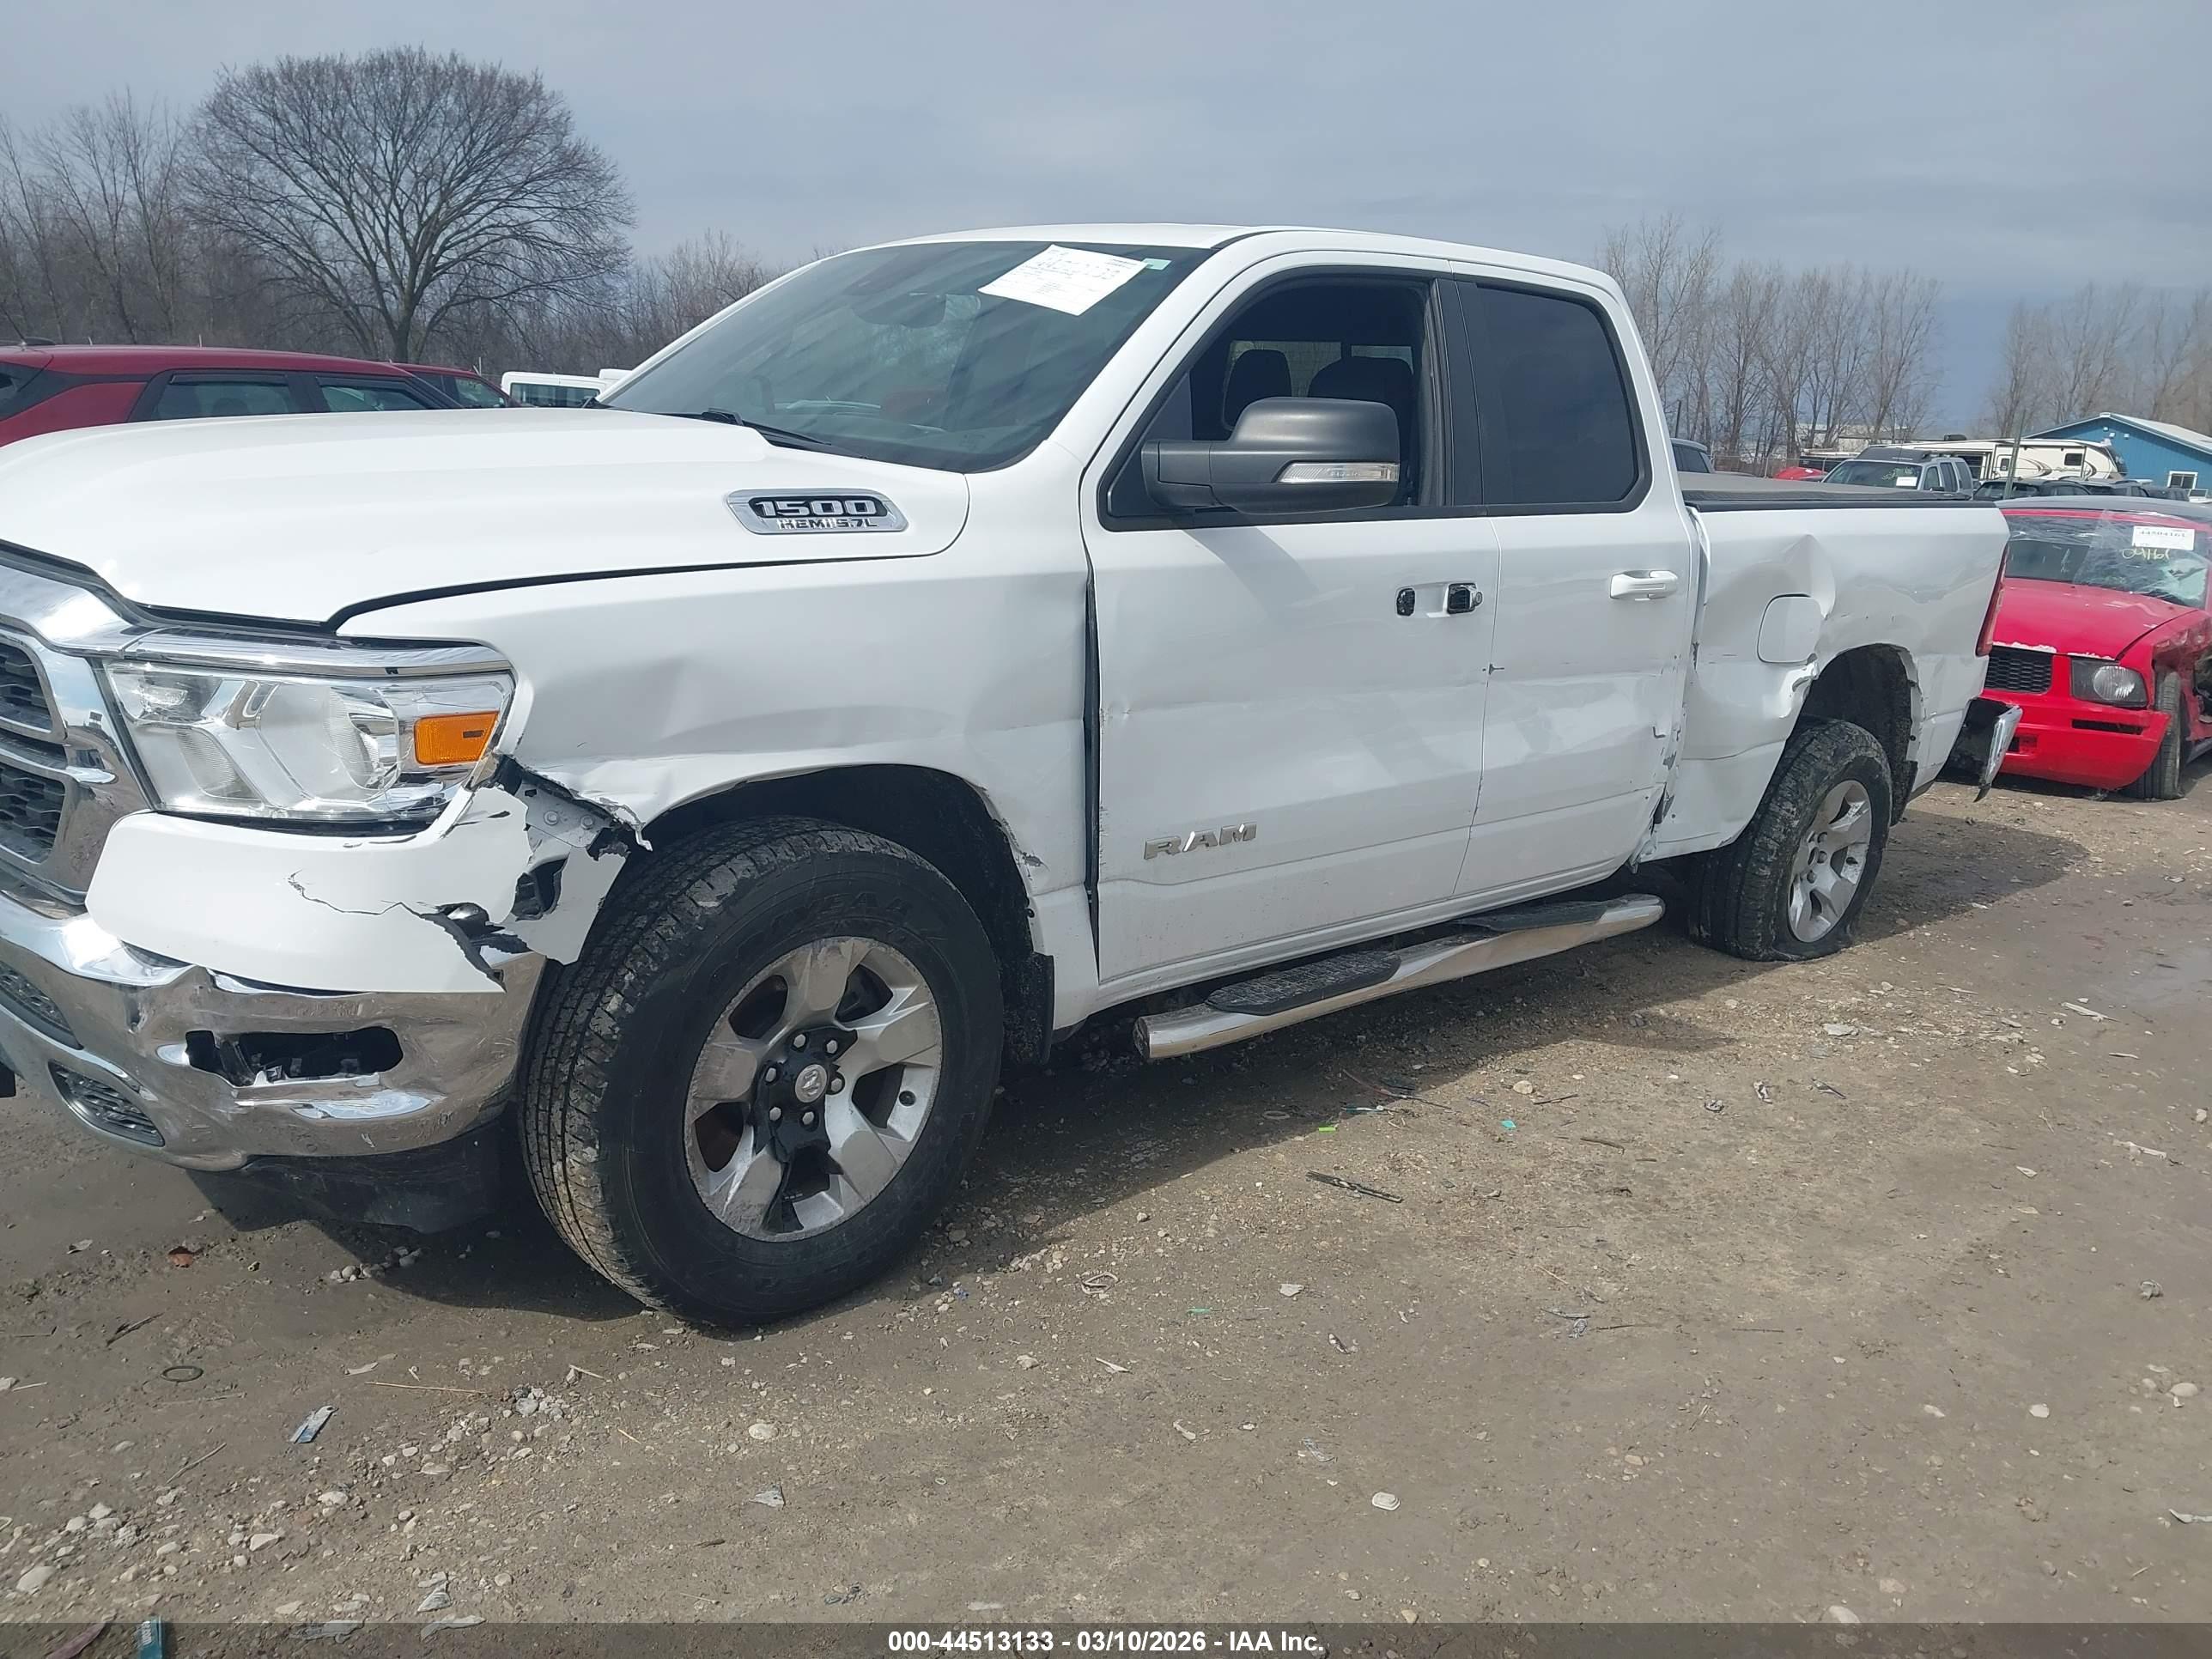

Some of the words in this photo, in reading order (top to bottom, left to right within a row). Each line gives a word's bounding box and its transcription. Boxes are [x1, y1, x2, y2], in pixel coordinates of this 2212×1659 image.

[756, 499, 878, 517] 1500
[779, 517, 831, 530] HEMI
[836, 517, 878, 529] 5.7L
[1144, 822, 1257, 860] RAM
